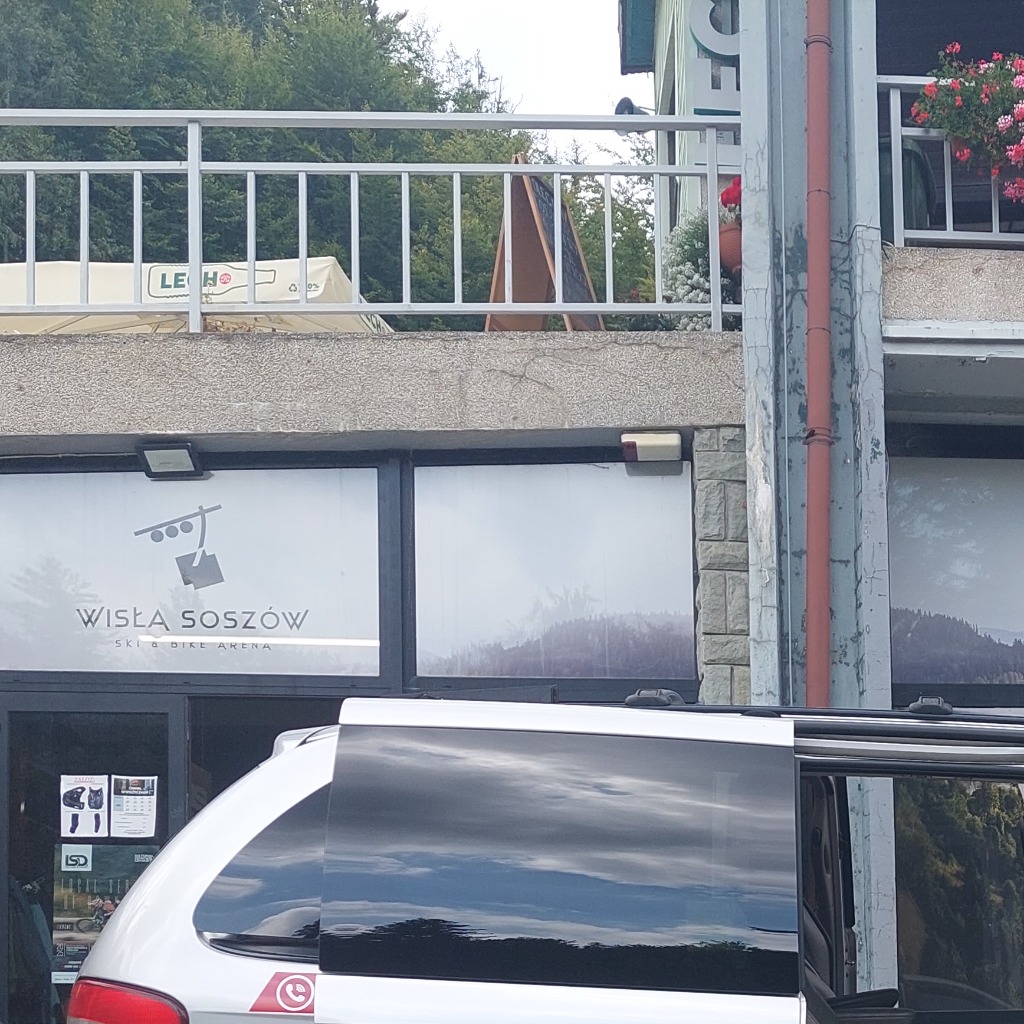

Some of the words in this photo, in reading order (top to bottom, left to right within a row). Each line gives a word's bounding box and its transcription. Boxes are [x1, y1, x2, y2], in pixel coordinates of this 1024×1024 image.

[161, 271, 218, 289] LEH
[76, 606, 170, 631] WISŁA
[181, 606, 309, 631] SOSZÓW
[115, 638, 140, 648] SKI
